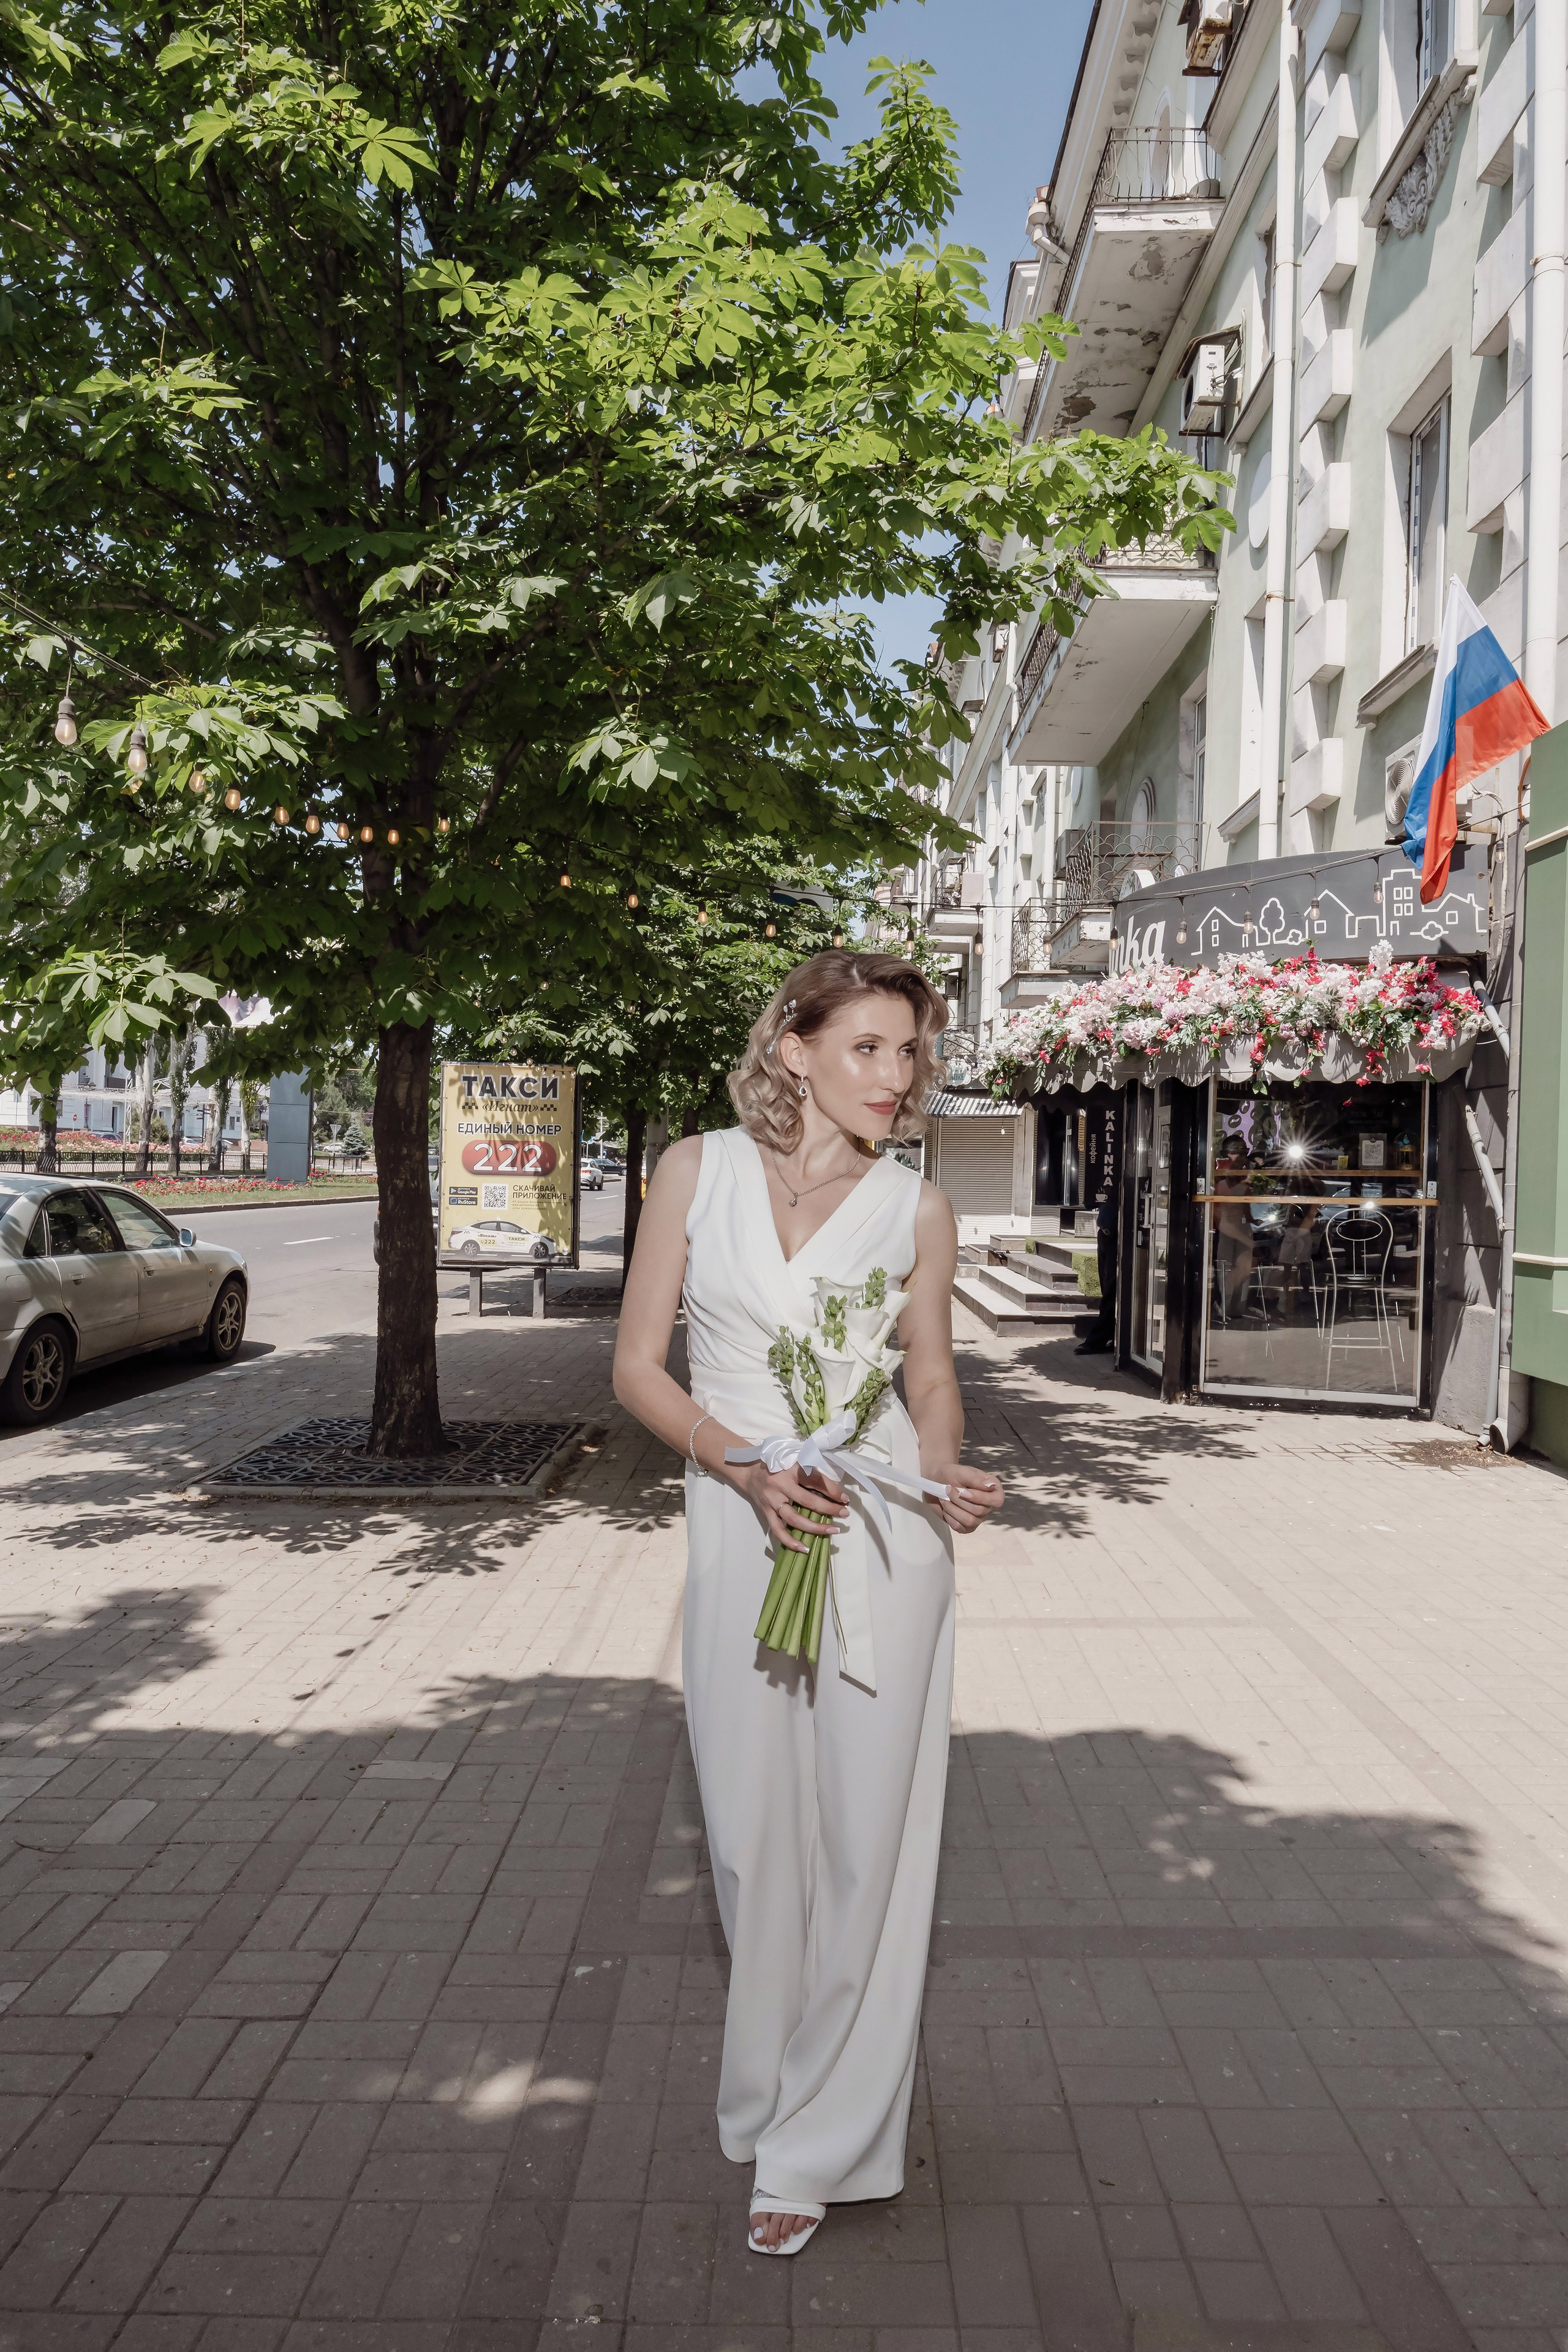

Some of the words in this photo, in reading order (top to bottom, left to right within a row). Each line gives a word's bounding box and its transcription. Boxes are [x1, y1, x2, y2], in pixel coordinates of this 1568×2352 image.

[462, 1075, 559, 1099] ТАКСИ
[482, 1100, 539, 1113] «Игнат»
[458, 1121, 512, 1135] ЕДИНЫЙ
[516, 1124, 562, 1136] НОМЕР
[473, 1143, 543, 1172] 222
[1103, 1110, 1115, 1186] KALINKA
